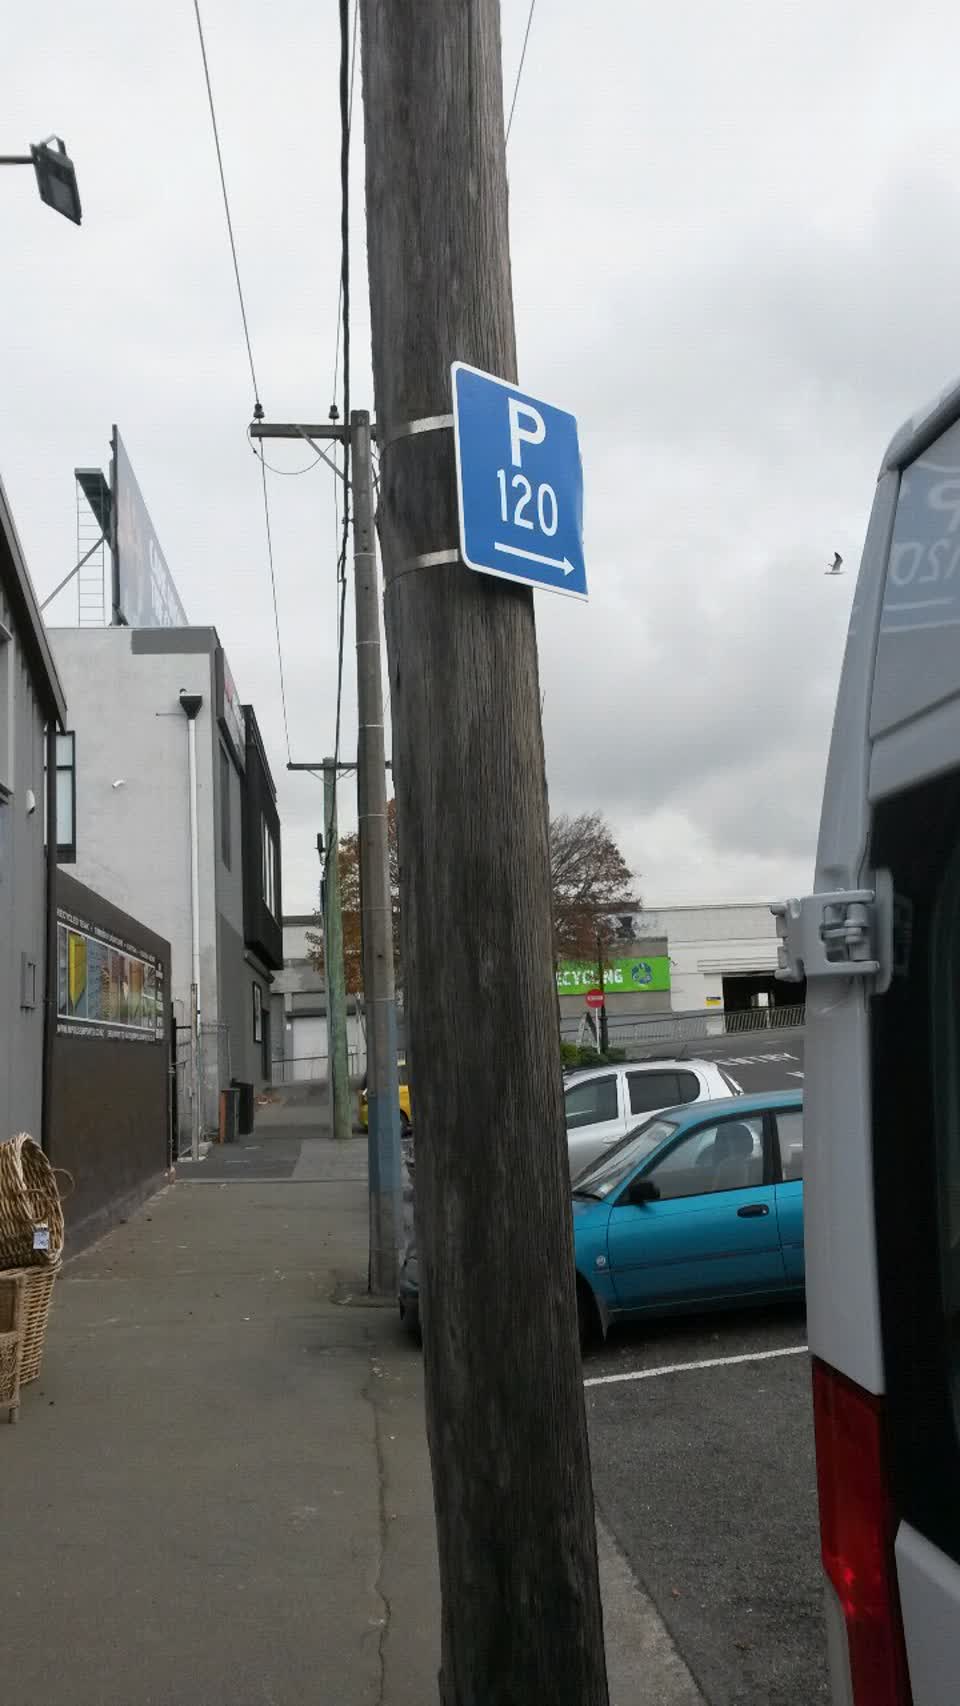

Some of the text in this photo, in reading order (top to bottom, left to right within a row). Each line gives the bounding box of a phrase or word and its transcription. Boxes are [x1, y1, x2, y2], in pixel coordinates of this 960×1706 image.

[508, 397, 546, 468] P
[497, 468, 558, 537] 120
[556, 968, 624, 986] ECYCLNG
